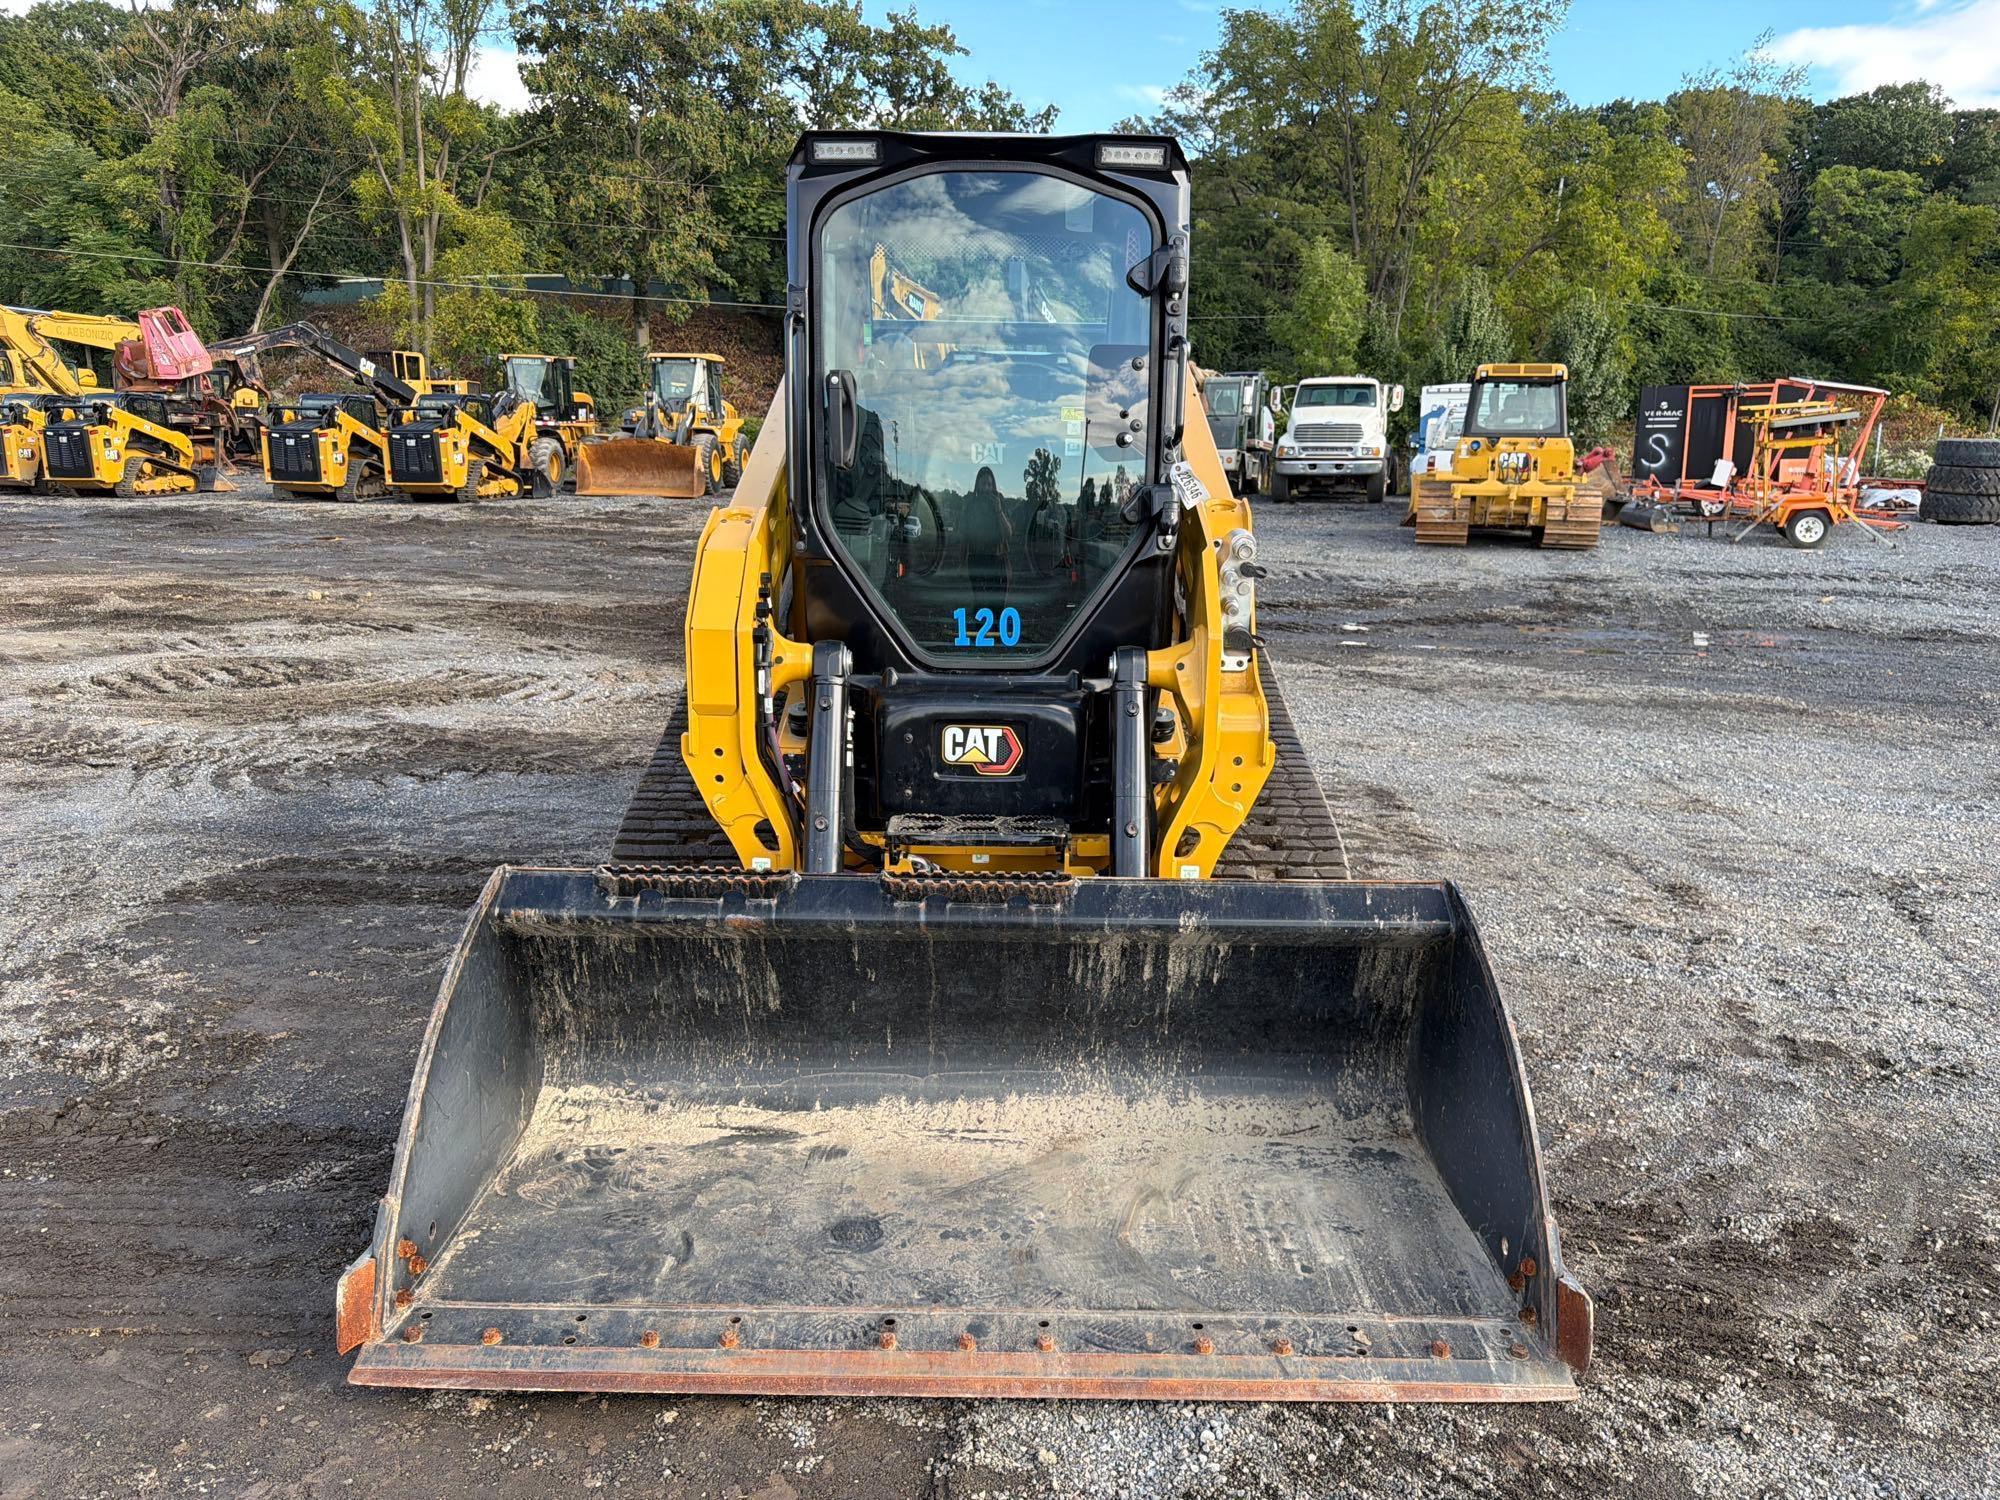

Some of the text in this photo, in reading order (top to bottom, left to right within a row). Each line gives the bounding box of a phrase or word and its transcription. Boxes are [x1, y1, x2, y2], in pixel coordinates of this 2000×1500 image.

[56, 325, 114, 341] C. ABBONIZIO
[360, 357, 376, 378] CAT
[18, 449, 32, 459] CAT
[105, 450, 118, 460] CAT
[971, 442, 1007, 465] CAT
[1499, 452, 1527, 468] CAT
[1177, 470, 1203, 500] 226346
[953, 607, 1021, 647] 120
[944, 726, 1003, 763] CAT
